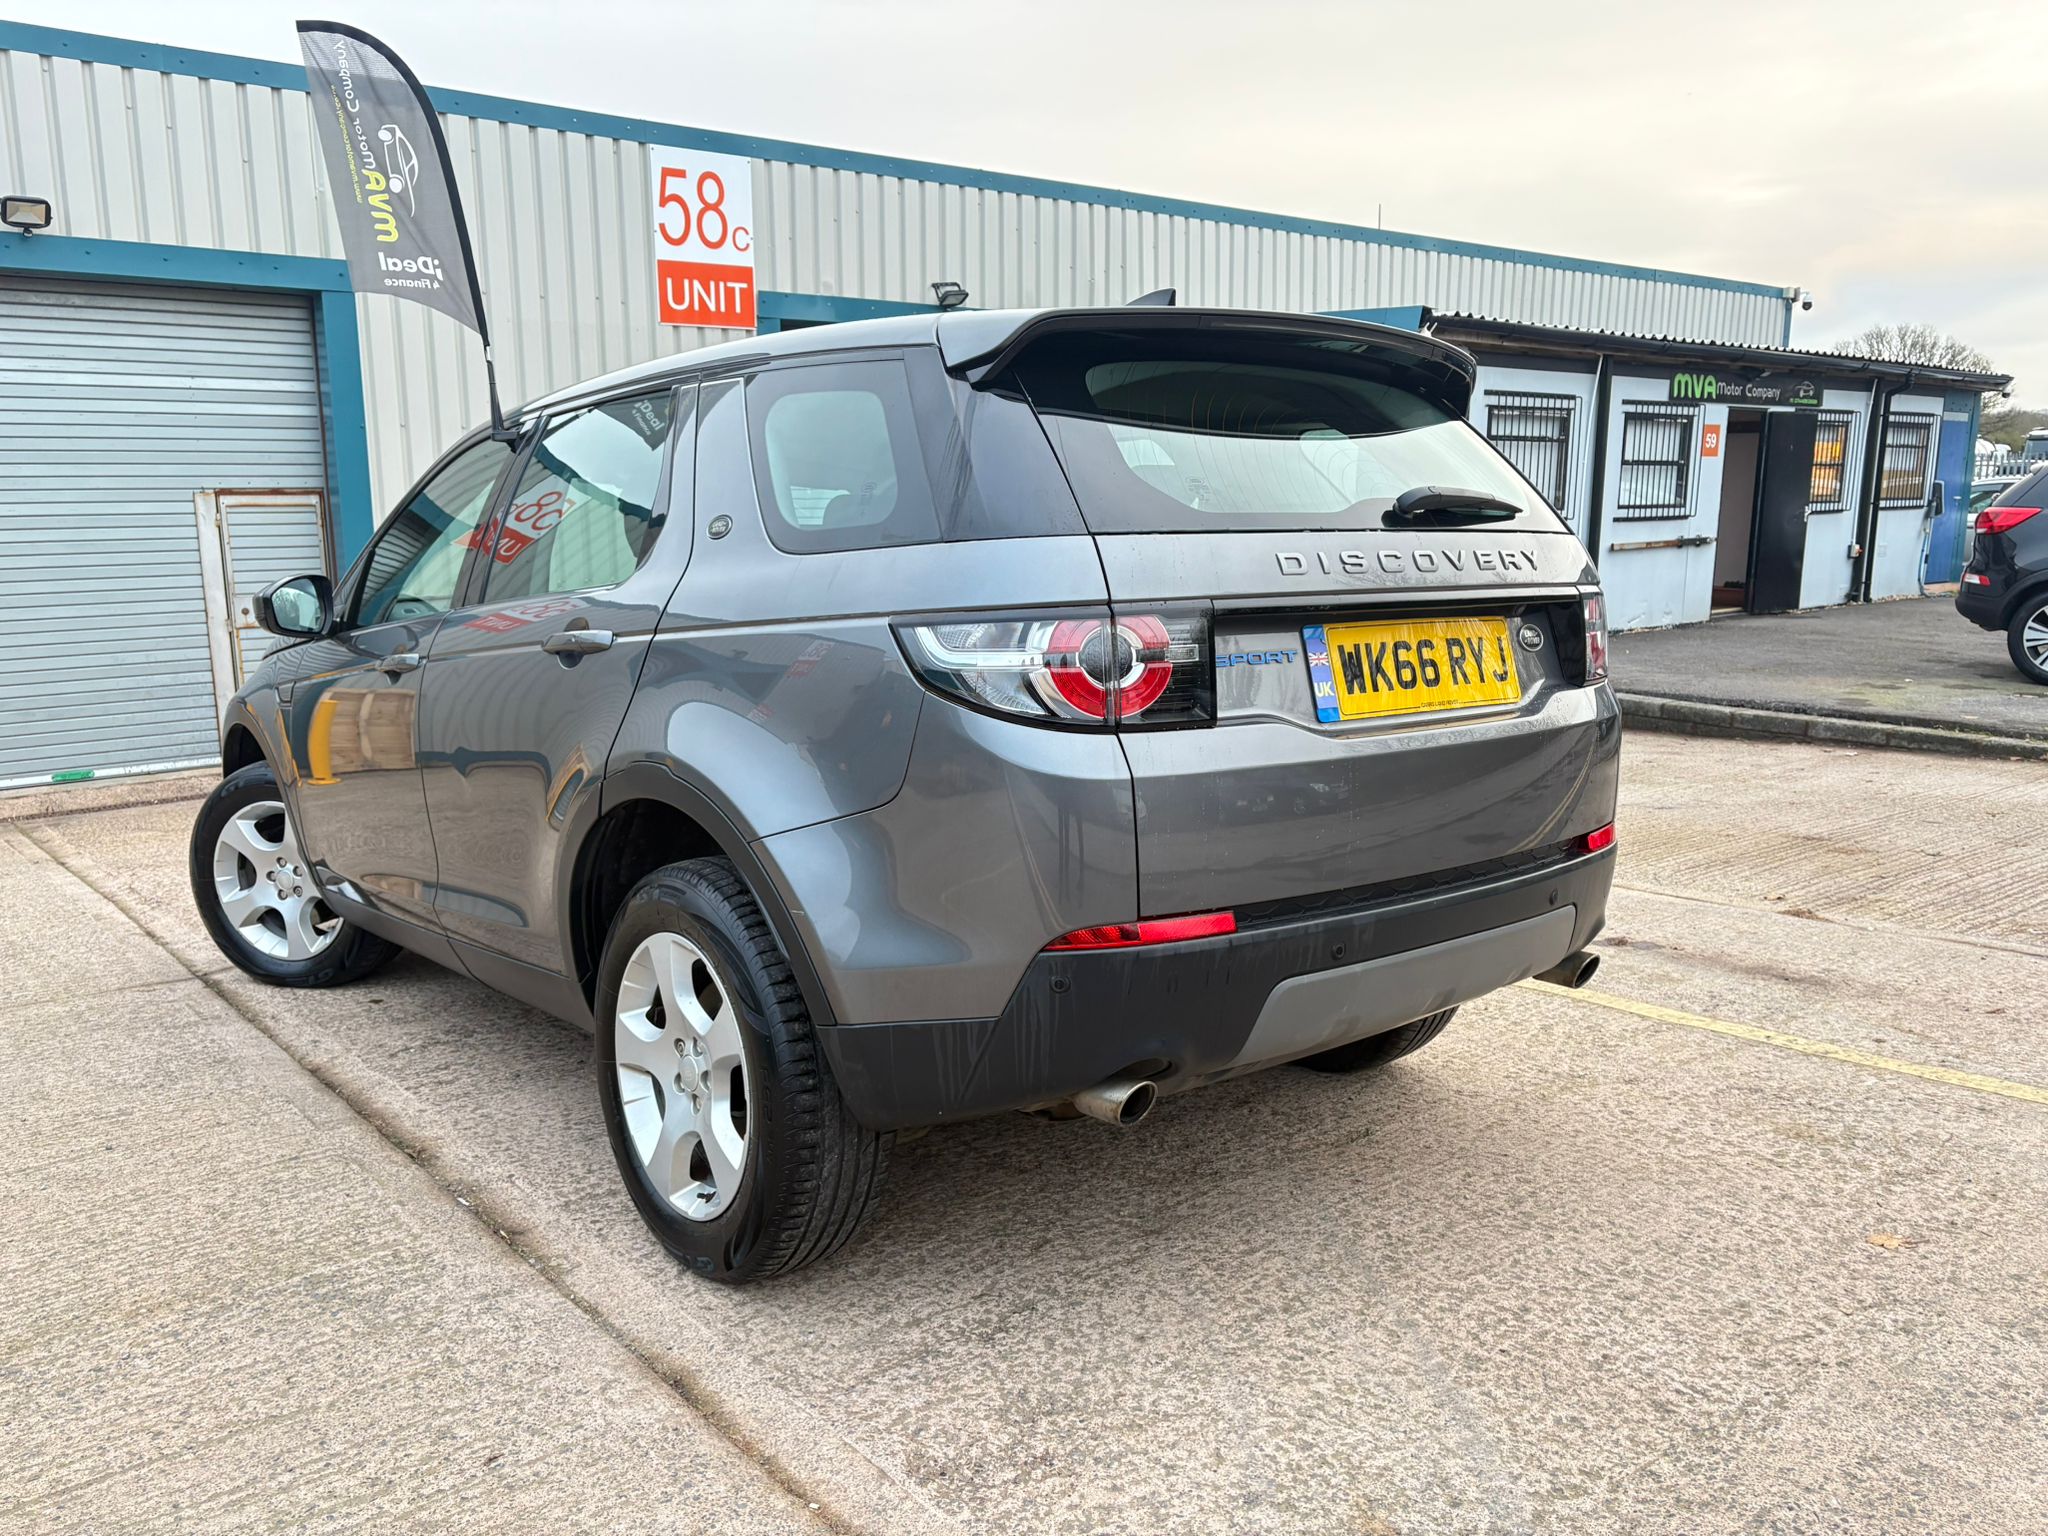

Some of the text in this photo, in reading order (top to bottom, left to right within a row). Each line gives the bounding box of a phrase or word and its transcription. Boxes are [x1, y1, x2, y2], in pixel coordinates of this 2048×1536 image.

[666, 276, 748, 314] UNIT
[1673, 373, 1716, 399] MVA
[1716, 381, 1743, 396] Motor
[1745, 383, 1781, 401] Company
[1705, 433, 1717, 448] 59
[1276, 550, 1538, 574] DISCOVERY
[1215, 650, 1297, 668] SPORT
[1337, 635, 1510, 695] WK66 RYJ
[1315, 680, 1335, 697] UK
